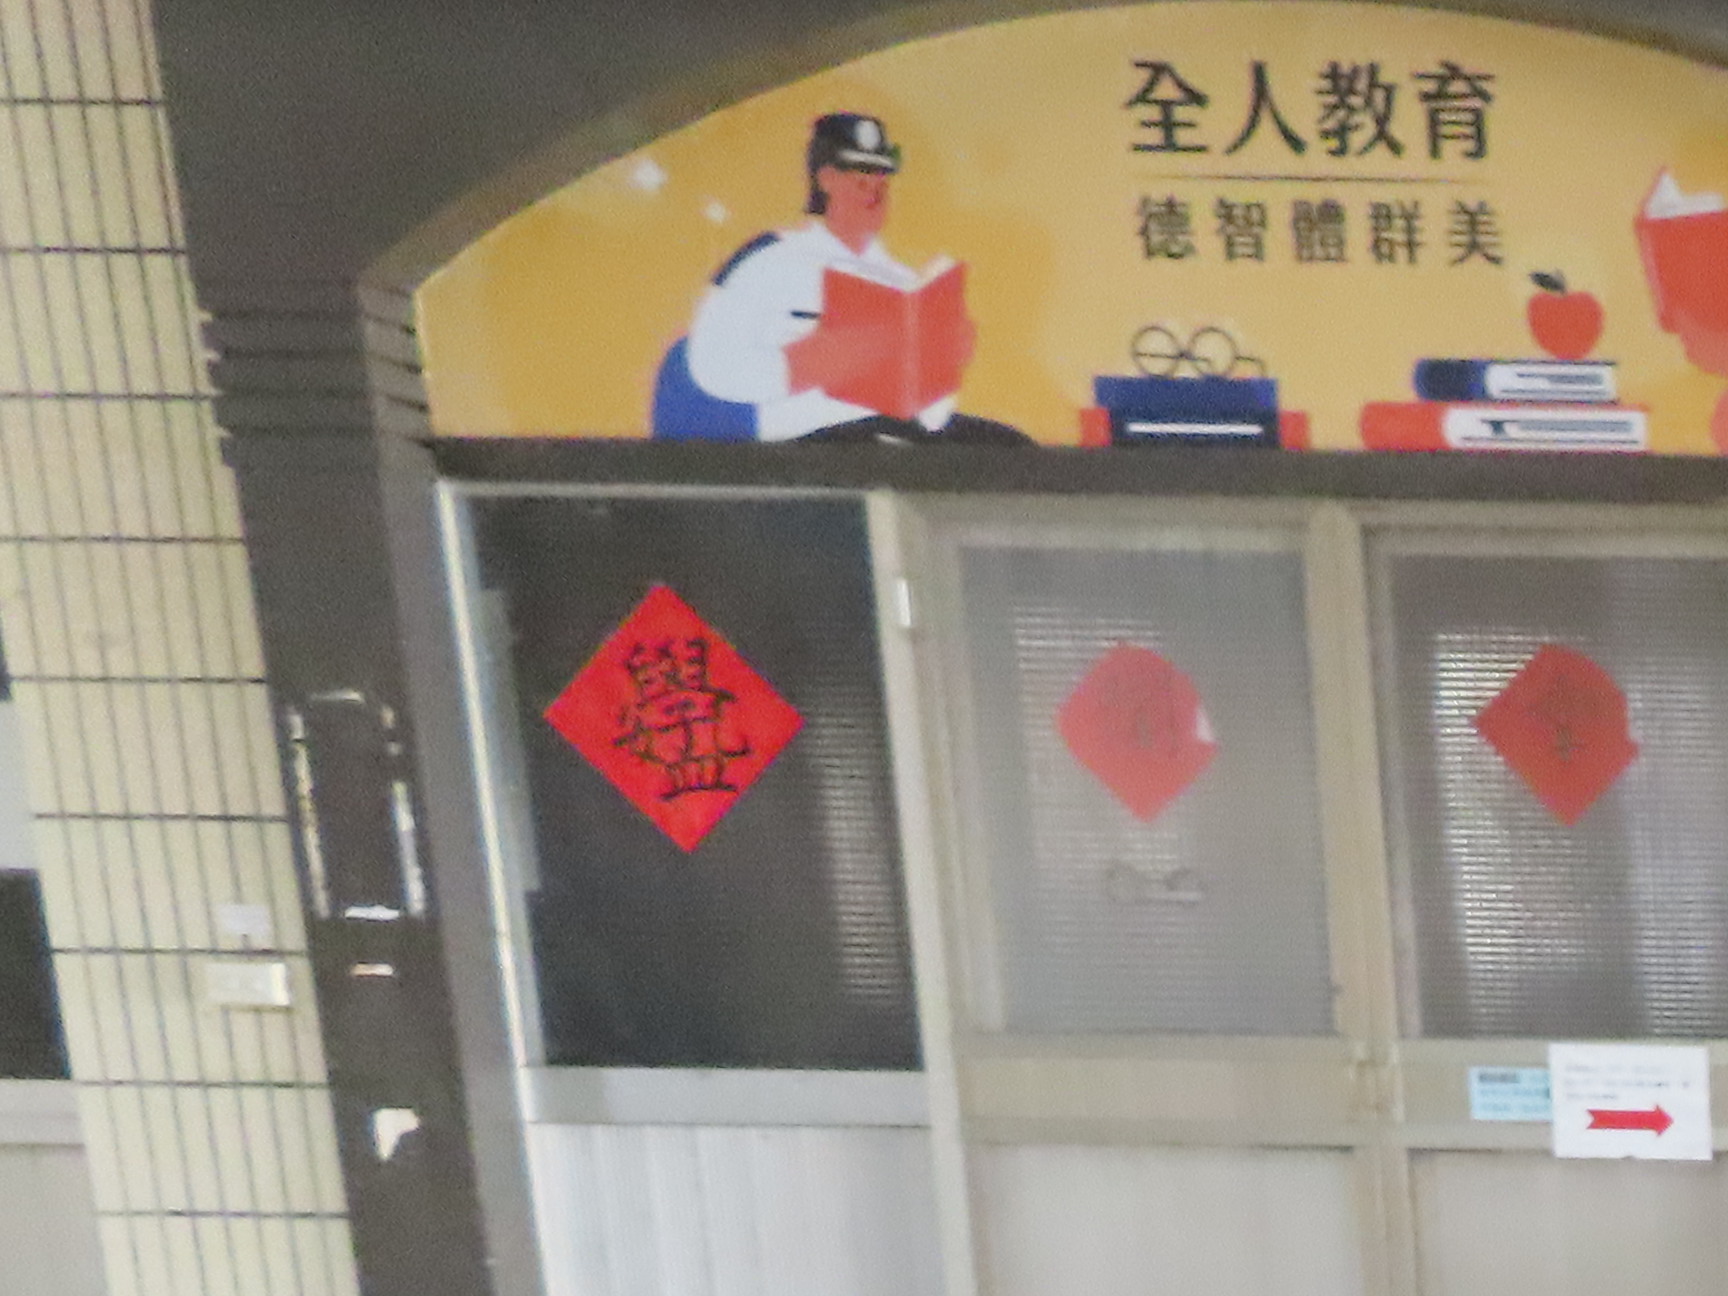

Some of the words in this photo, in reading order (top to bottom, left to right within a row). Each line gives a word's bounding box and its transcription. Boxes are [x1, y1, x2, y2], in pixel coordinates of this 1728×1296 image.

[1125, 58, 1497, 161] 全人教育
[1137, 194, 1505, 266] 德智體群美
